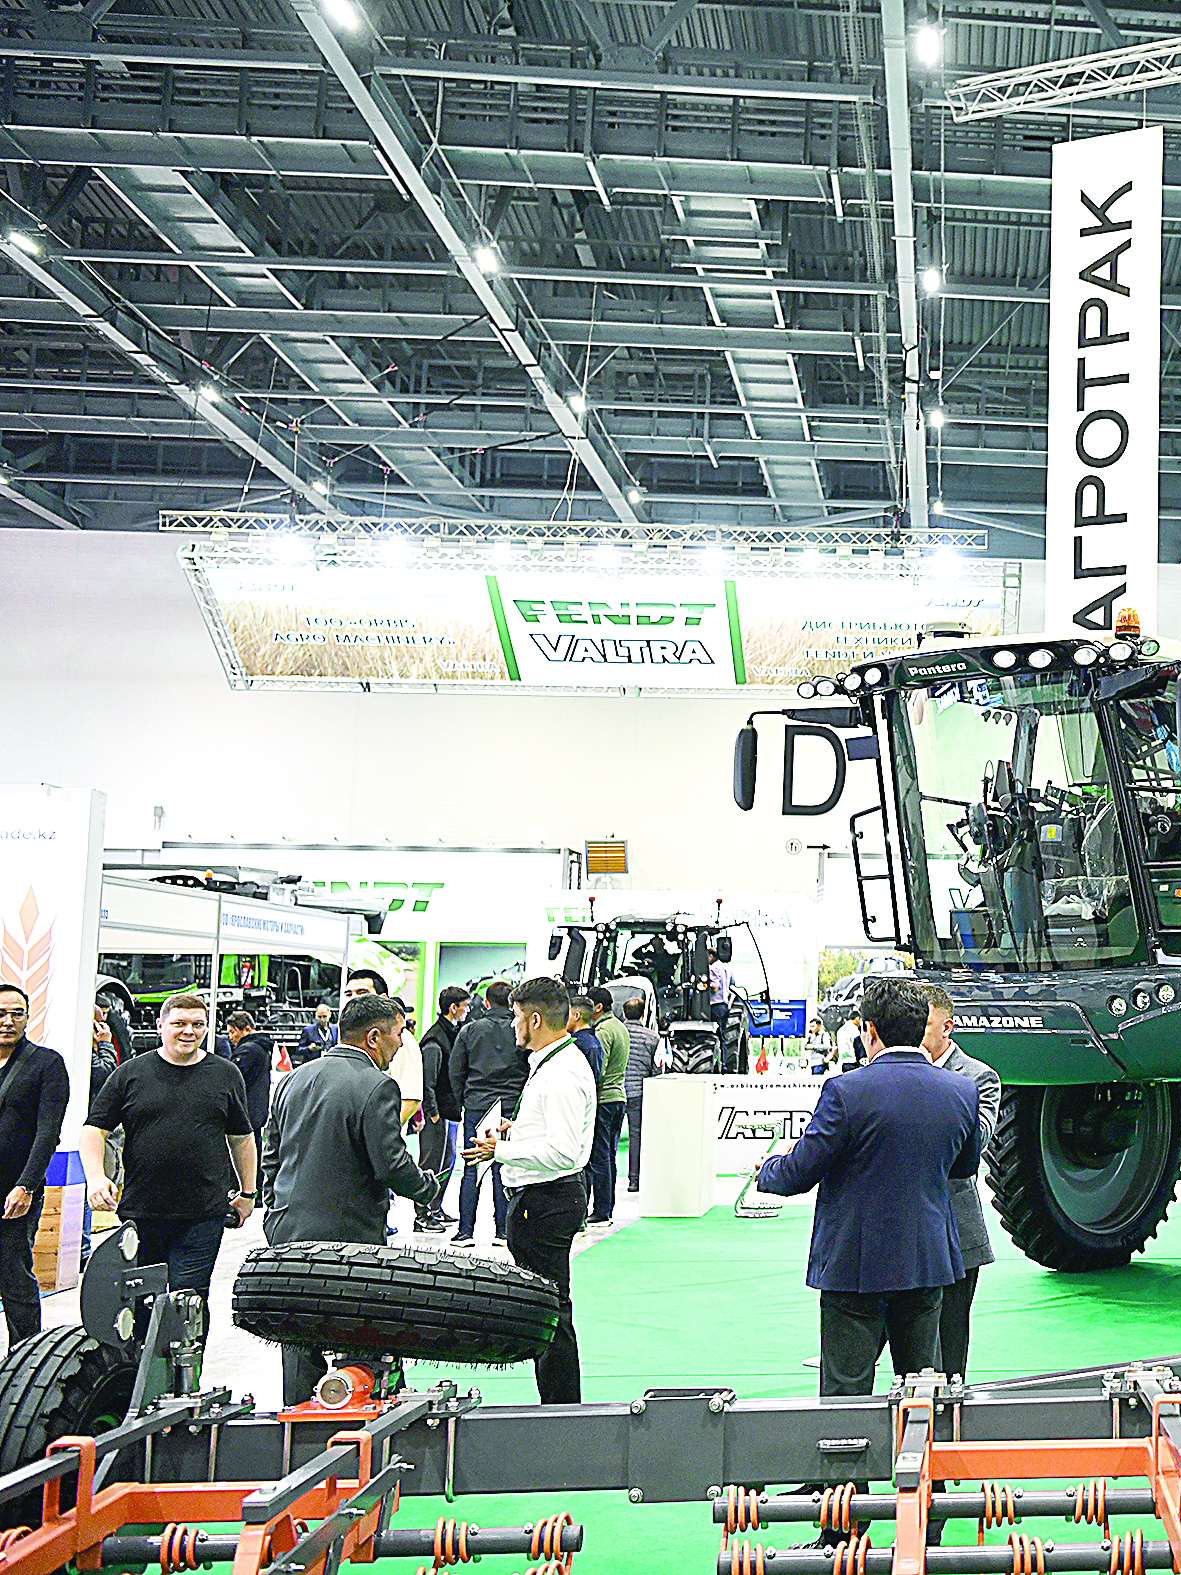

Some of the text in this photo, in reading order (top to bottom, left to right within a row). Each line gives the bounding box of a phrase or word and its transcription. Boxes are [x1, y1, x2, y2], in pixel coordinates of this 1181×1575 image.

[1073, 180, 1133, 630] АГРОТРАК
[513, 600, 716, 626] FENDT
[274, 632, 457, 646] AGRO MACHINERY»
[529, 633, 715, 665] VALTRA
[836, 636, 913, 646] ТЕХНИКИ
[805, 650, 856, 659] FENDT
[862, 650, 875, 659] И
[907, 662, 967, 677] Pantera
[782, 724, 847, 816] D
[952, 1014, 1044, 1028] AMAZONE
[717, 1106, 813, 1140] ALTR
